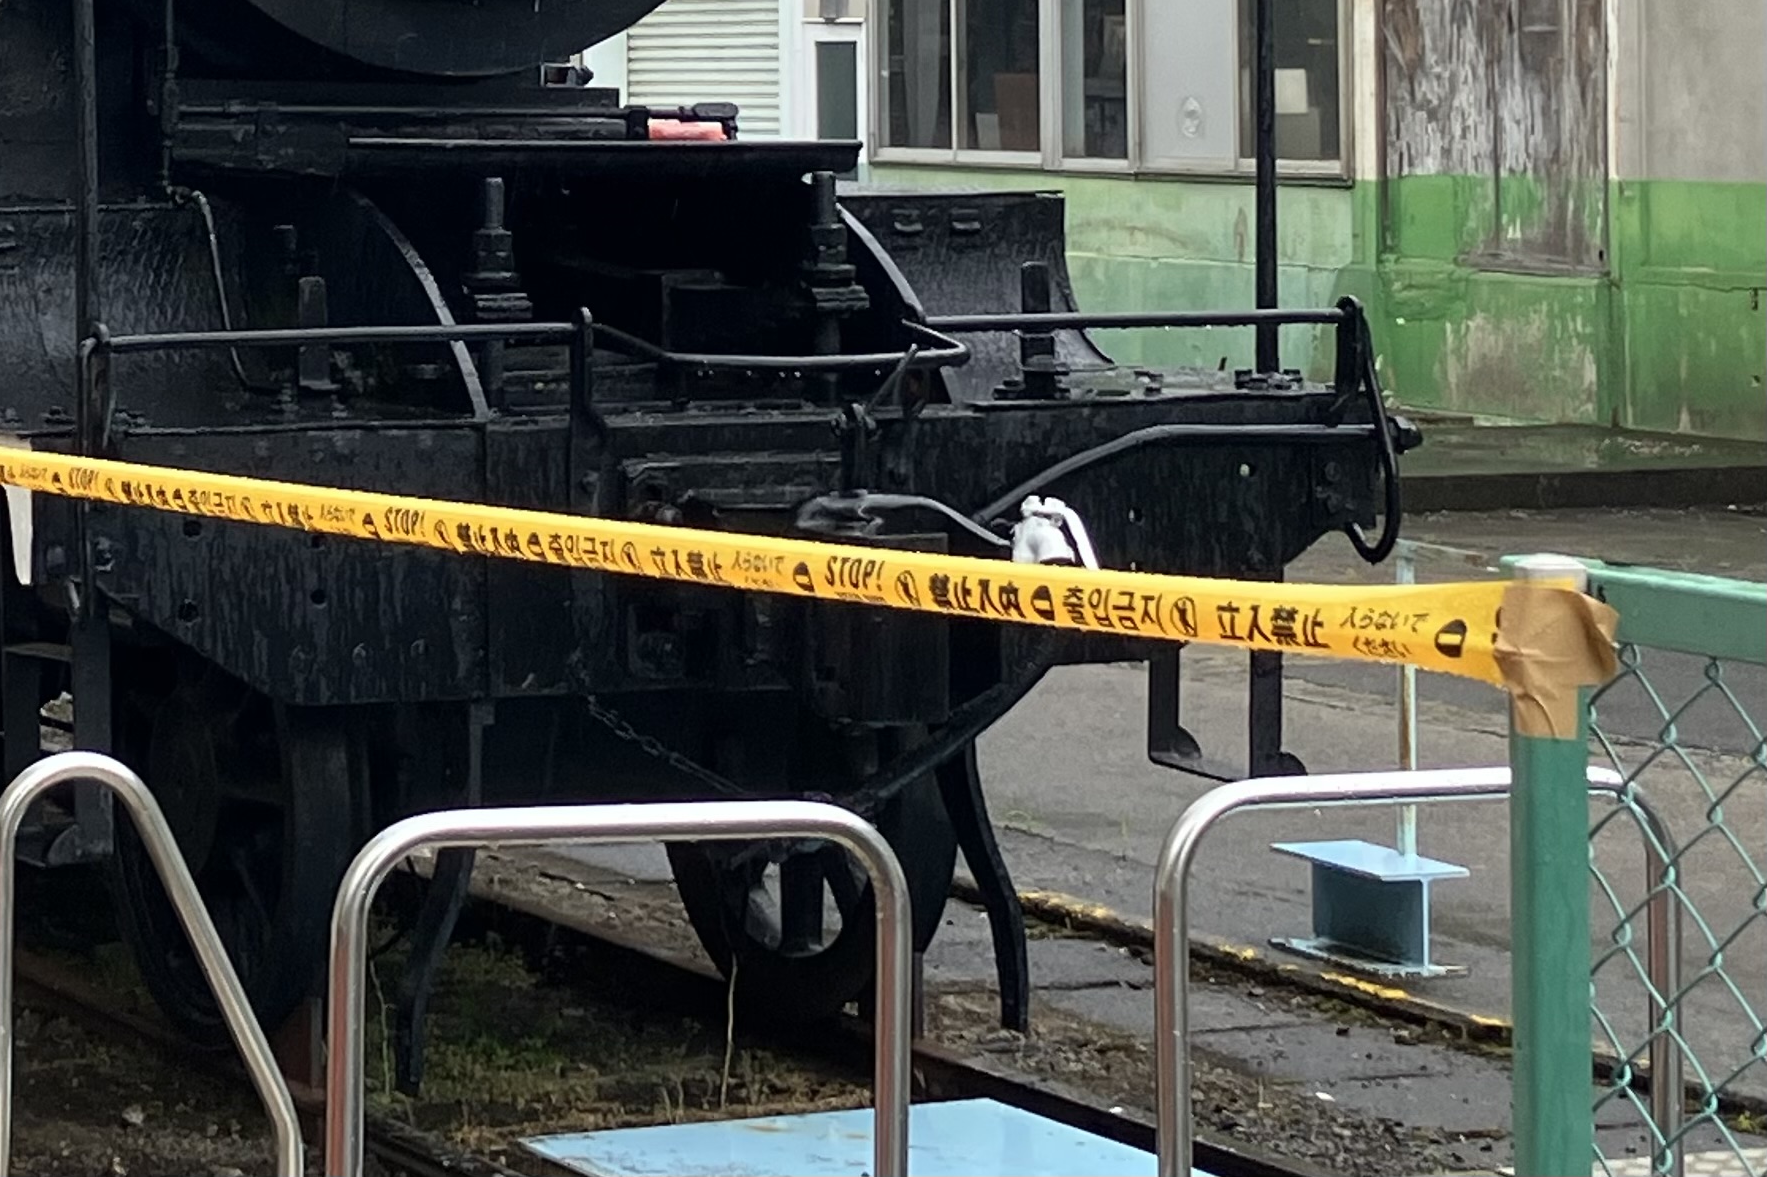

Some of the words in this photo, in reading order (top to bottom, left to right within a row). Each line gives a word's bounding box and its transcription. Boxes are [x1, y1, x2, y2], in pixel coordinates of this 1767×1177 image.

[384, 506, 426, 537] STOP!
[824, 556, 885, 591] STOP!
[1062, 586, 1169, 636] 출입금지
[1216, 600, 1333, 649] 立入禁止
[1339, 605, 1430, 634] 入らないで
[1353, 634, 1413, 659] ください
